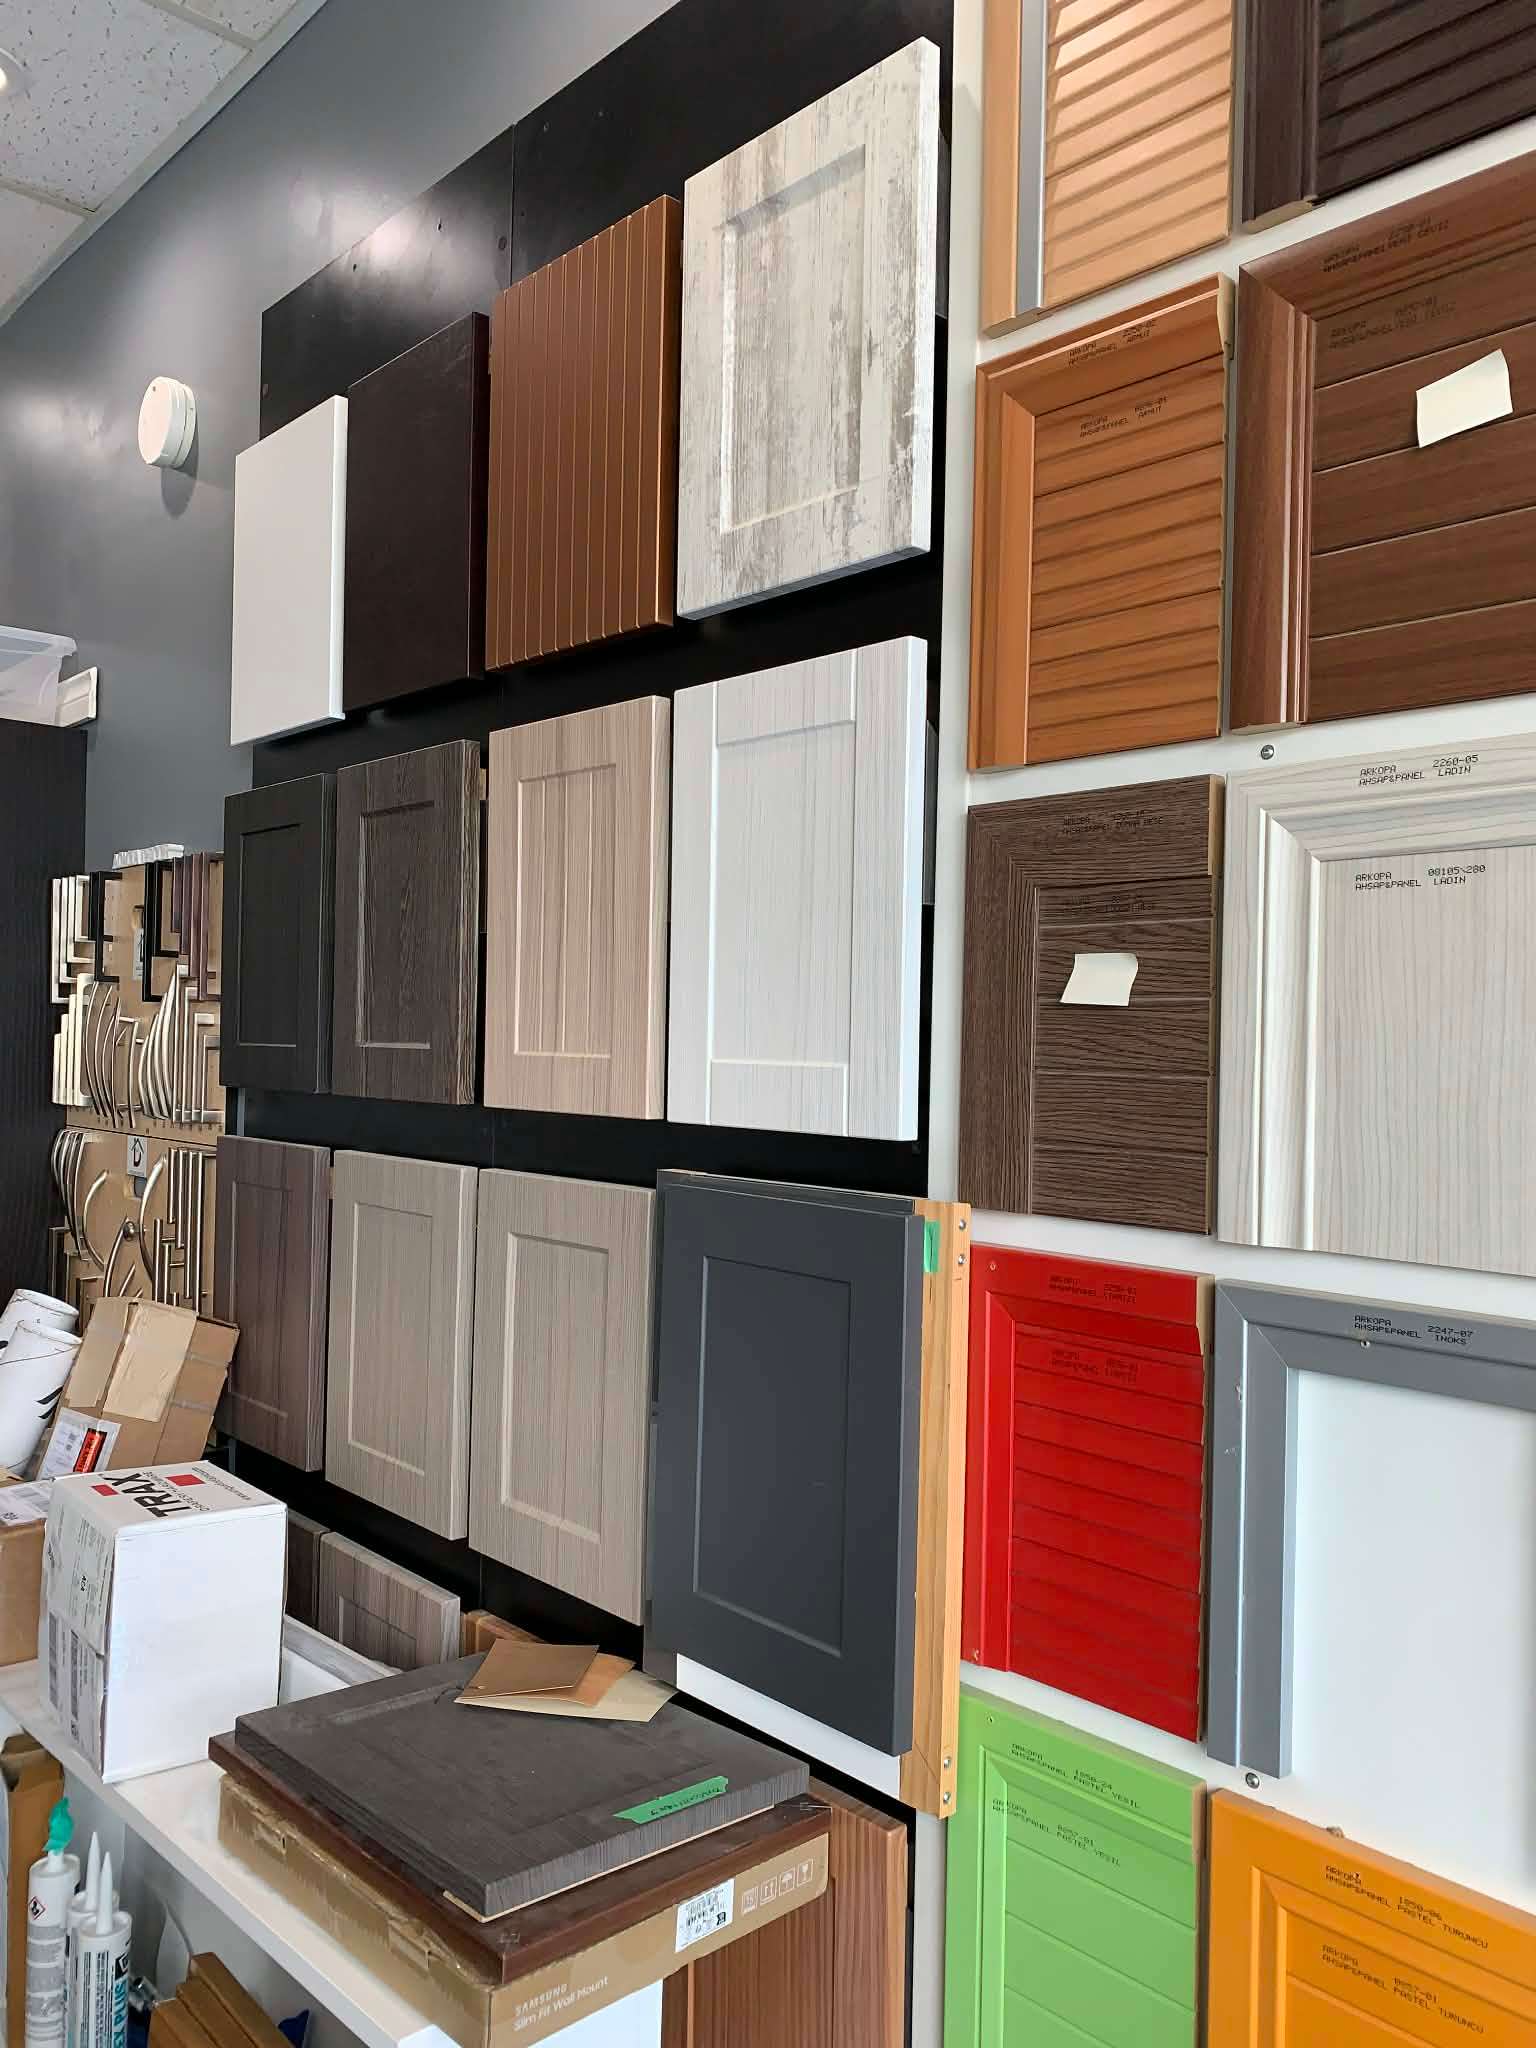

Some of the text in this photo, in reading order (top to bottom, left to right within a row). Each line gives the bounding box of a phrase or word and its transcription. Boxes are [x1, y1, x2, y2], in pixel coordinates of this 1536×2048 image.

[1360, 754, 1479, 777] ARKOPA 2260-05
[1438, 766, 1471, 777] LADIN
[1355, 871, 1392, 882] ARKOPA
[1433, 875, 1466, 886] LADIN
[1354, 1314, 1474, 1338] ARKOPA 2247-07
[104, 1472, 192, 1518] TRAX
[115, 1982, 126, 2026] PLUS
[513, 1976, 608, 2032] Slim Fit Wall Mount
[515, 1983, 568, 2017] SAMSUNG
